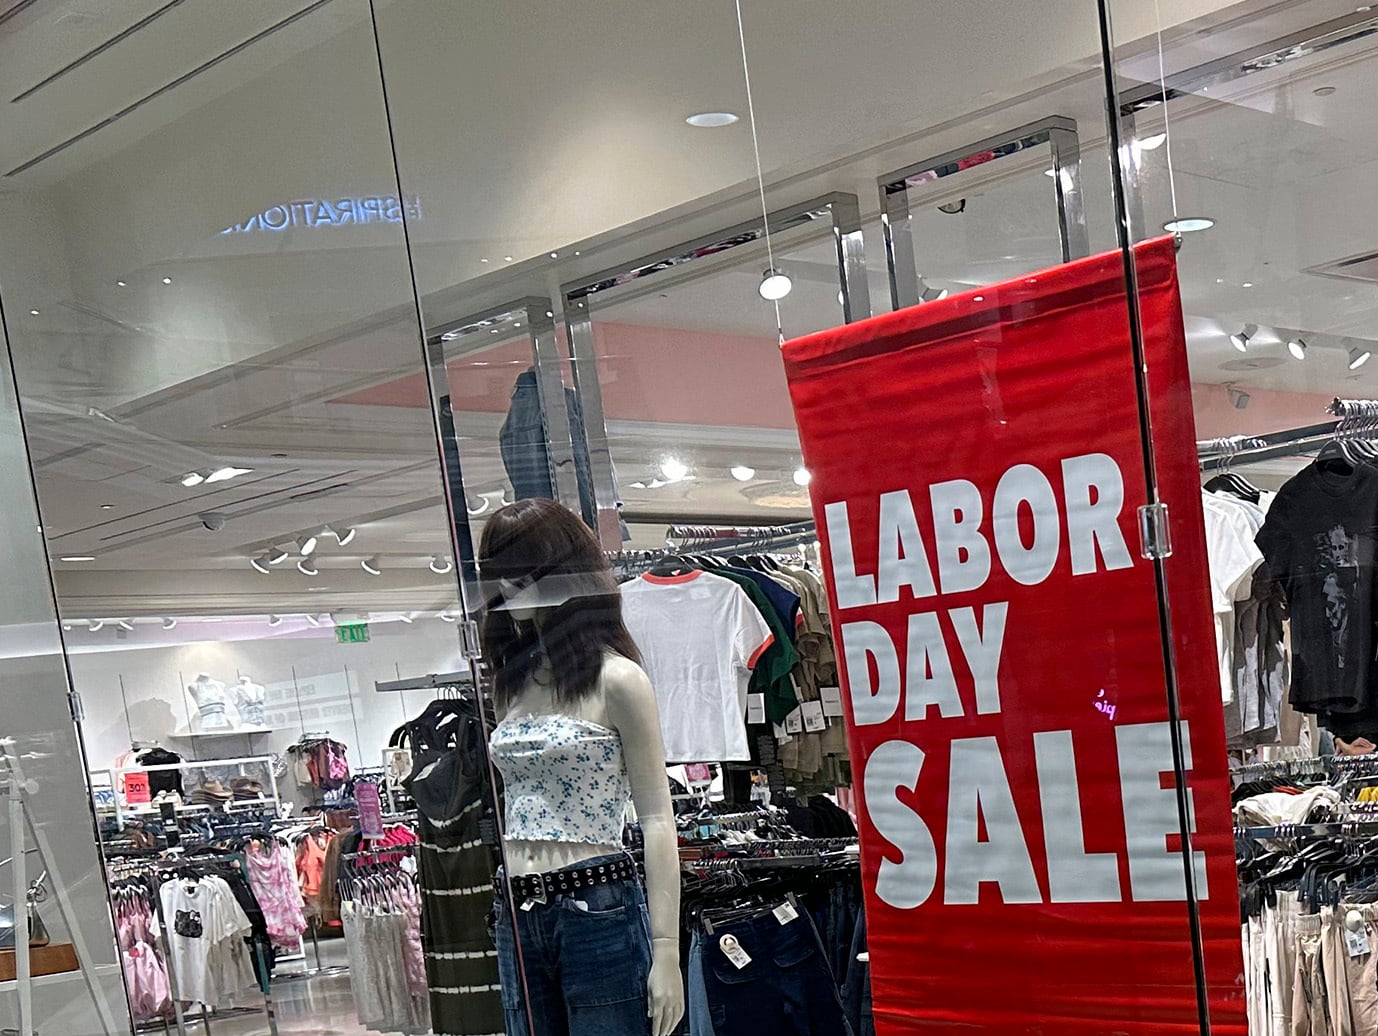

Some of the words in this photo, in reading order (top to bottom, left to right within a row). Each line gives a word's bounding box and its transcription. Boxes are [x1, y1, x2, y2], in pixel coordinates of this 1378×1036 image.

[824, 452, 1135, 611] LABOR
[840, 601, 1009, 727] DAY
[863, 720, 1210, 910] SALE
